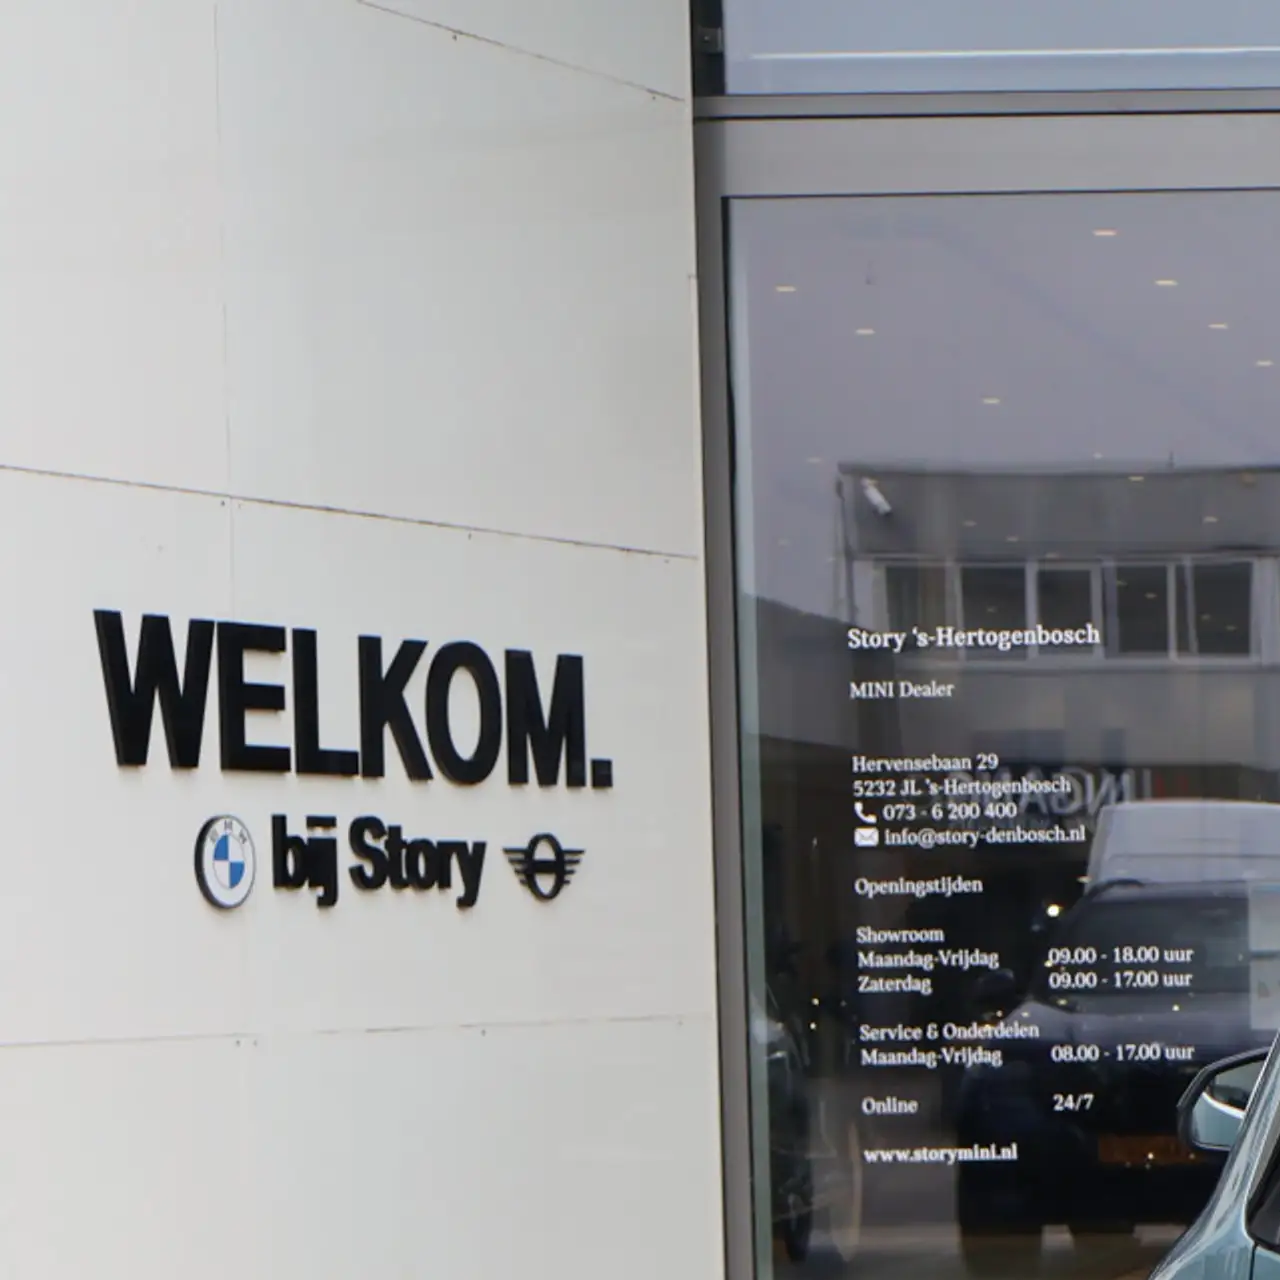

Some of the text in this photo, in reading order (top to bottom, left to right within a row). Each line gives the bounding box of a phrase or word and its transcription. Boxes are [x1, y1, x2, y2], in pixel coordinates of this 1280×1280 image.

[847, 628, 907, 653] Story
[93, 609, 613, 788] WELKOM.
[850, 679, 955, 699] MINI Dealer
[852, 752, 999, 773] Hervensebaan 29
[853, 779, 897, 797] 5232
[899, 779, 923, 796] JL
[882, 803, 917, 821] 073
[931, 802, 944, 820] 6
[947, 800, 981, 820] 200
[984, 801, 1018, 819] 400
[884, 823, 1086, 849] info@story-denbosch.nl
[271, 813, 338, 908] bij
[348, 815, 487, 908] Story
[854, 875, 984, 899] Openingstijden
[856, 925, 945, 944] Showroom
[857, 948, 1000, 971] Maandag-Vrijdag
[1048, 949, 1097, 964] 09.00
[1113, 946, 1160, 963] 18.00
[1163, 949, 1194, 963] uur
[857, 973, 933, 996] Zaterdag
[1048, 971, 1098, 989] 09.00
[1114, 970, 1160, 988] 17.00
[1162, 973, 1193, 987] uur
[859, 1022, 1039, 1042] Service & Onderdelen
[861, 1045, 1003, 1069] Maandag-Vrijdag
[1050, 1043, 1100, 1062] 08.00
[1116, 1041, 1162, 1061] 17.00
[1164, 1046, 1195, 1060] uur
[861, 1093, 1094, 1115] Online 24/7
[863, 1142, 1018, 1166] www.storymini.nl
